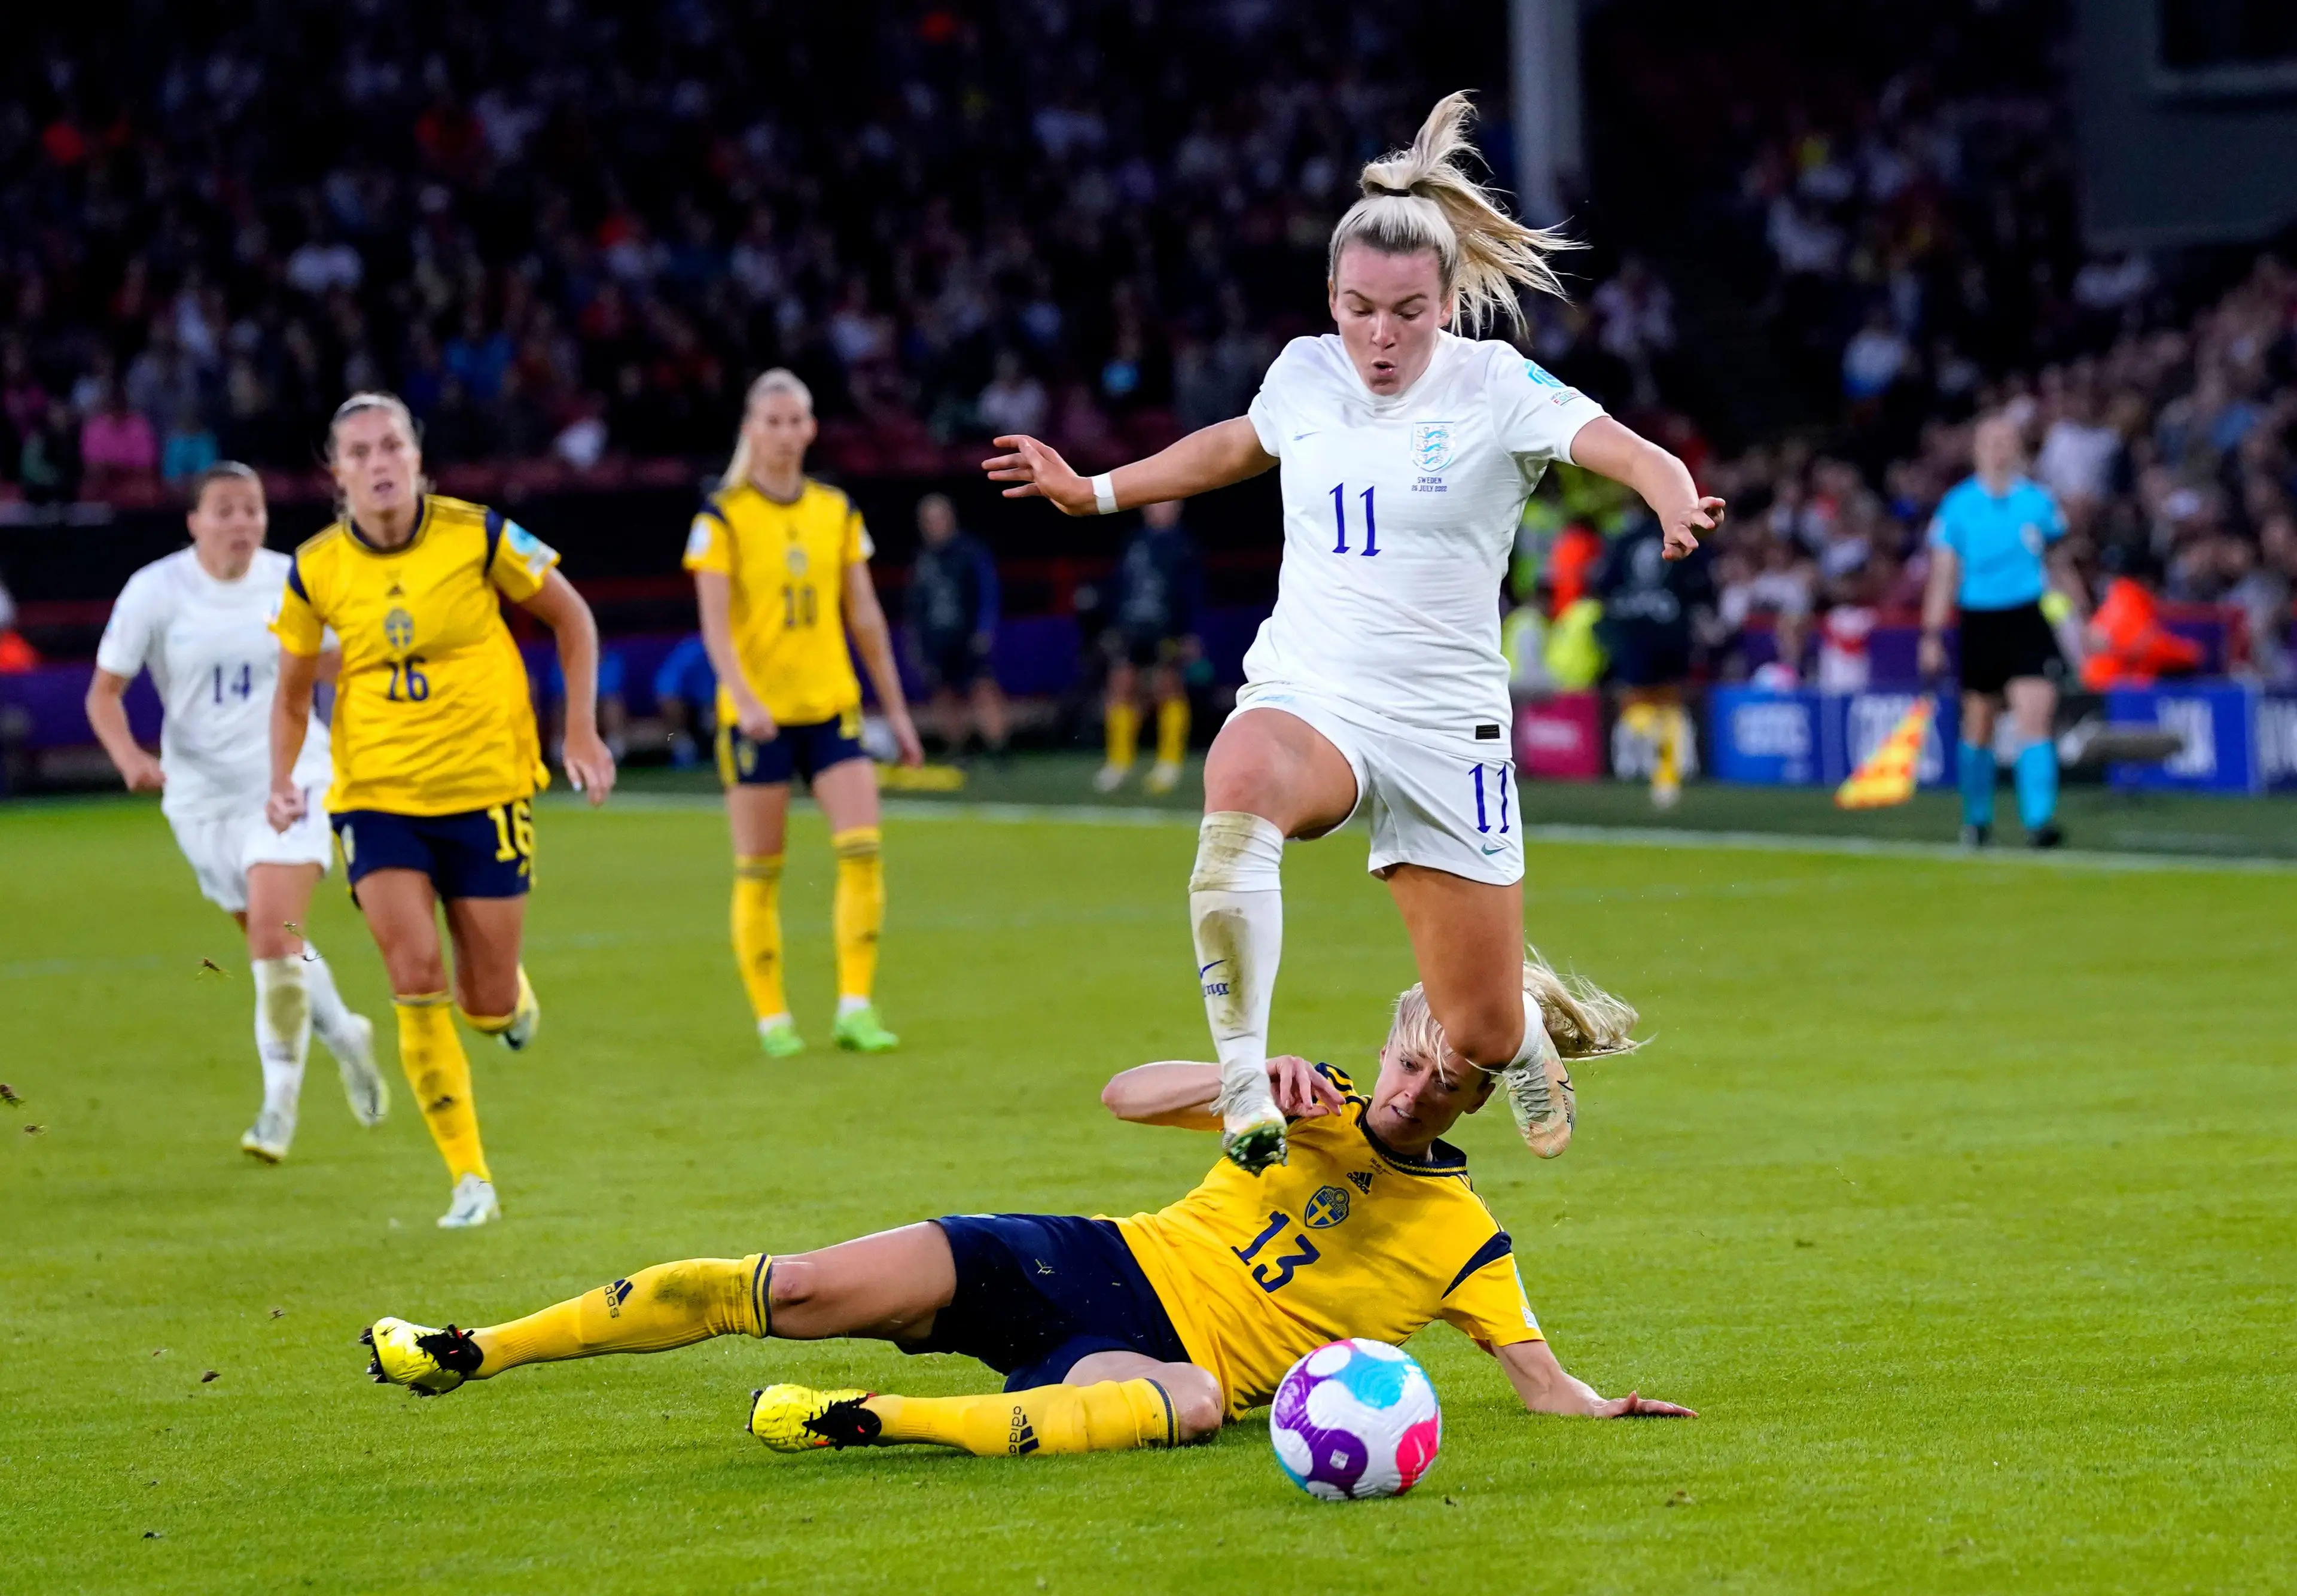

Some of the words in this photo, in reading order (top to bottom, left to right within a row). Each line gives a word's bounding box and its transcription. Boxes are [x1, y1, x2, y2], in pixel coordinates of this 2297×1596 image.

[1329, 482, 1382, 557] 11
[213, 663, 252, 704] 14
[1469, 763, 1510, 833] 11
[486, 800, 536, 863] 16
[1346, 1172, 1370, 1195] adidas
[1230, 1210, 1321, 1293] 13
[1009, 1406, 1023, 1454] adida
